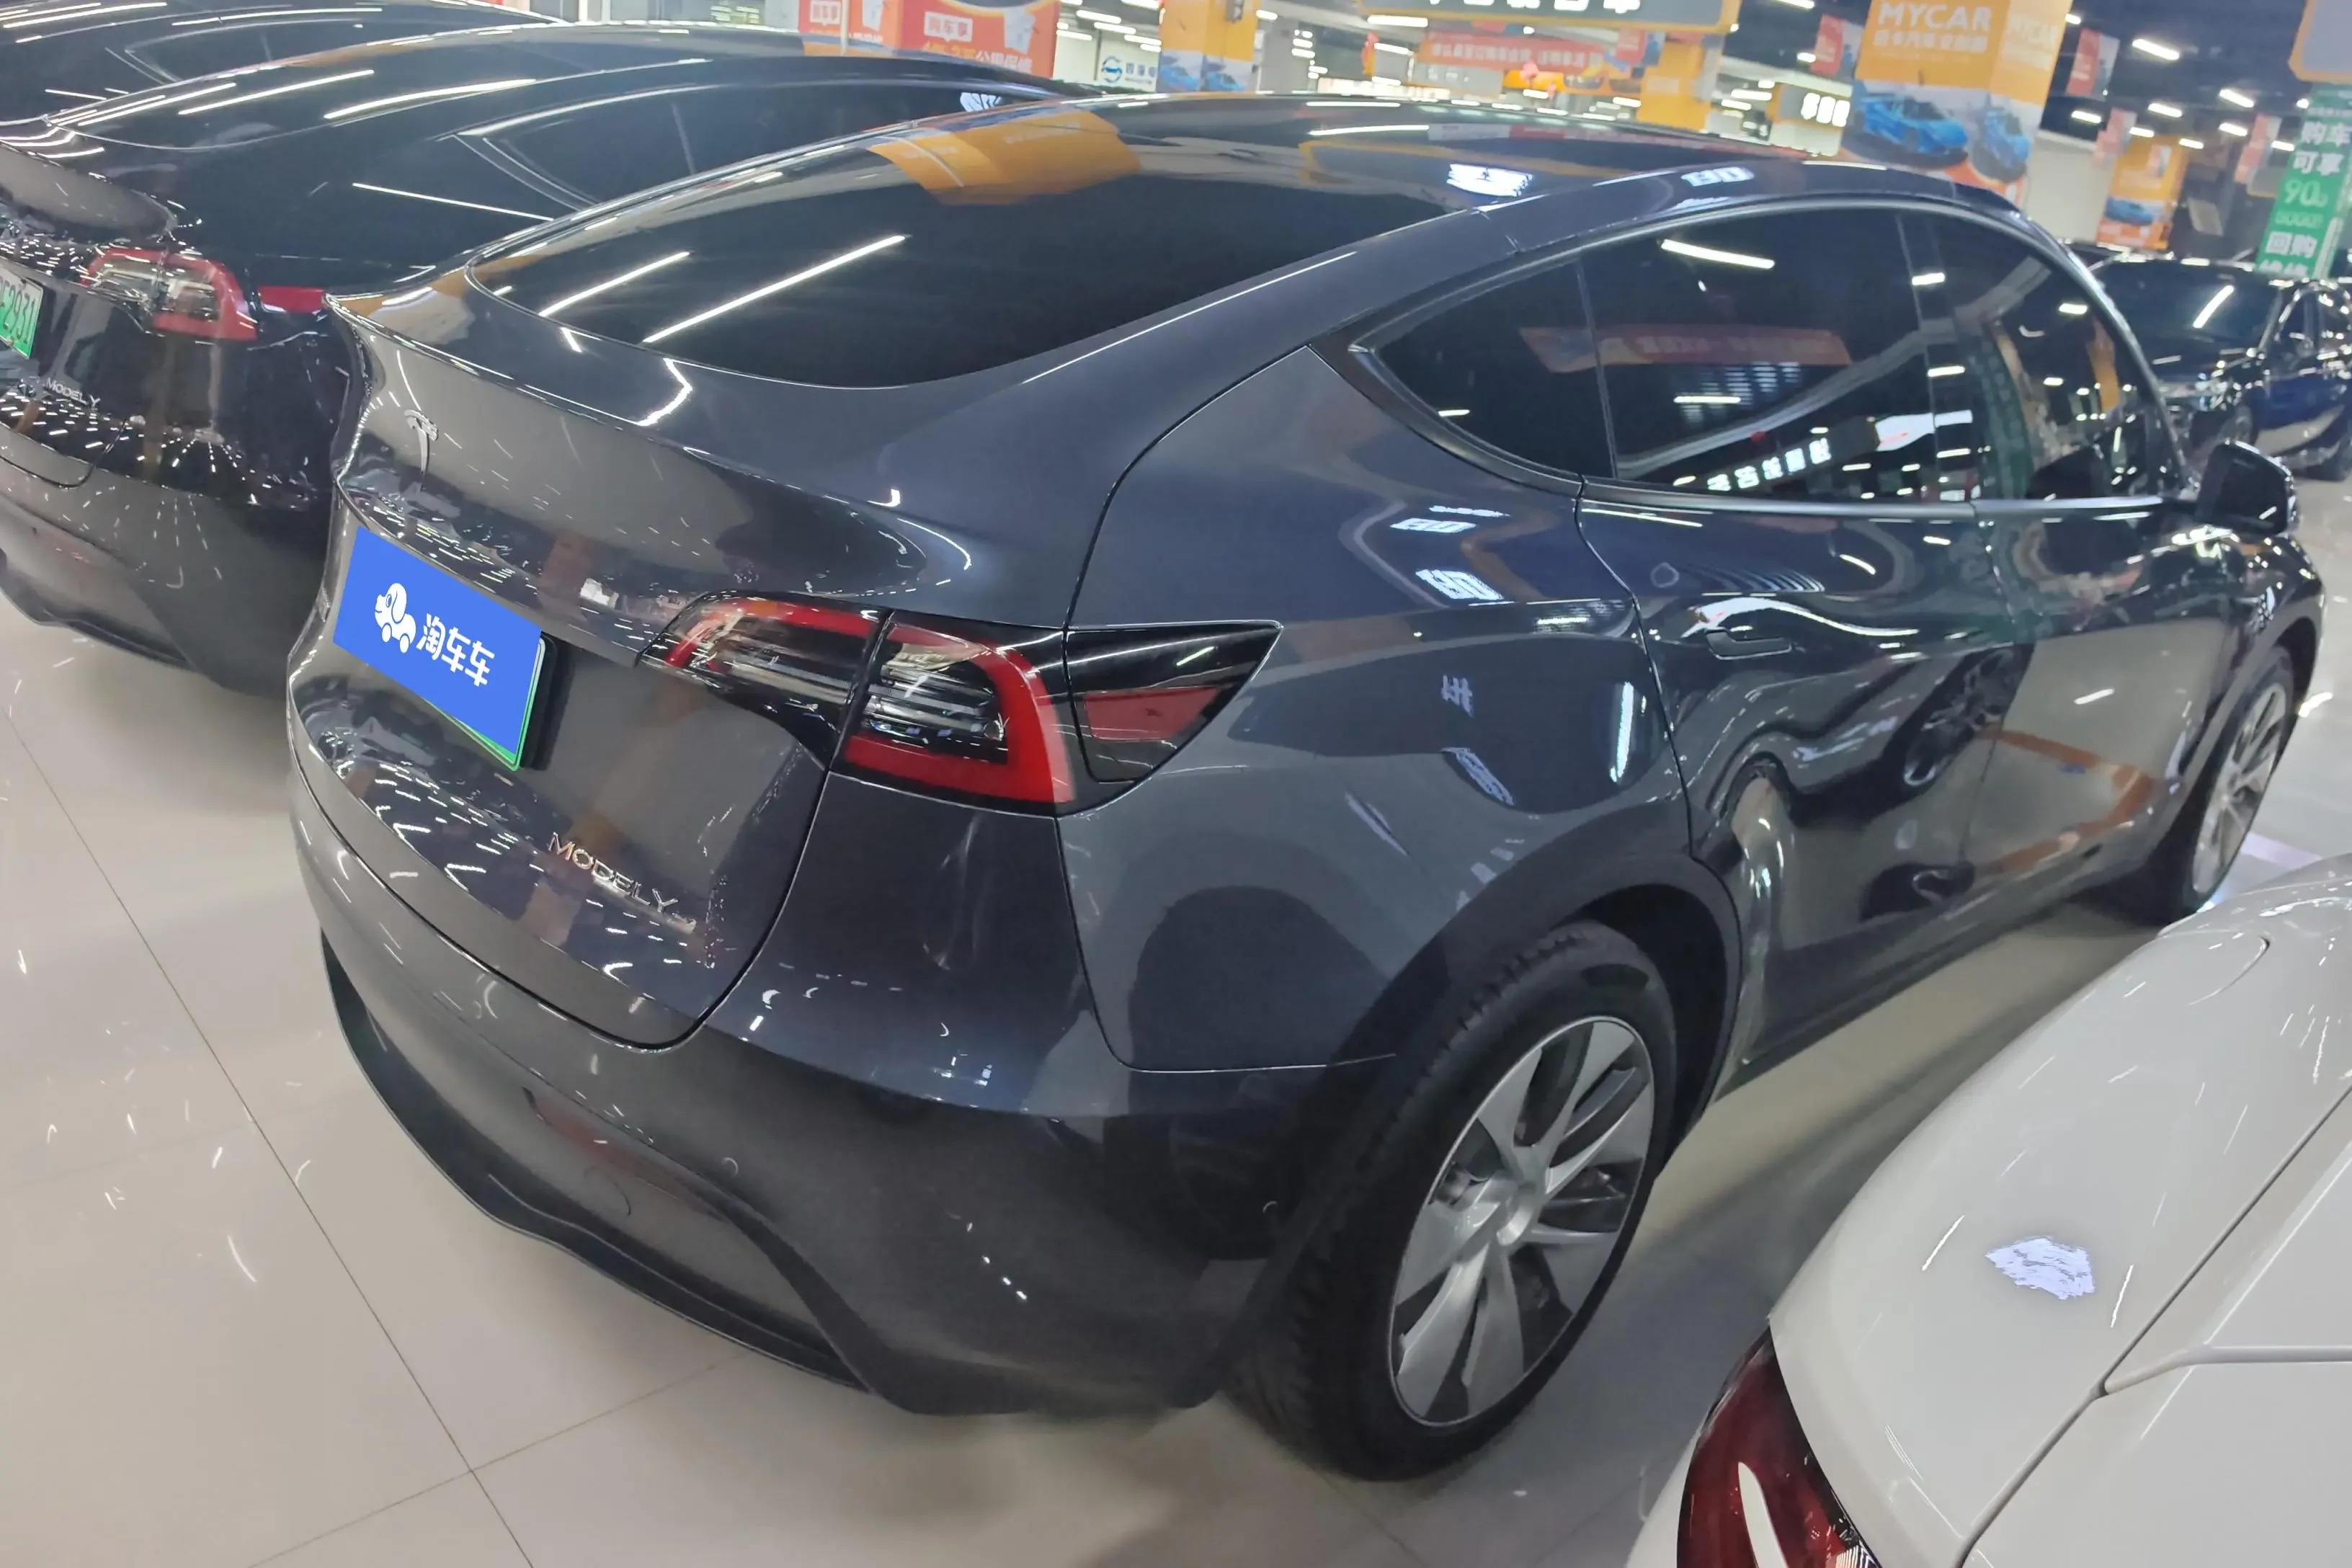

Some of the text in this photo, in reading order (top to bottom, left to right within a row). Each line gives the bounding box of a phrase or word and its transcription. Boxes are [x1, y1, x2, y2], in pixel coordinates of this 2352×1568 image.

[1877, 1, 1992, 31] MYCAR
[0, 275, 36, 344] F2931
[548, 831, 679, 914] MODEL Y
